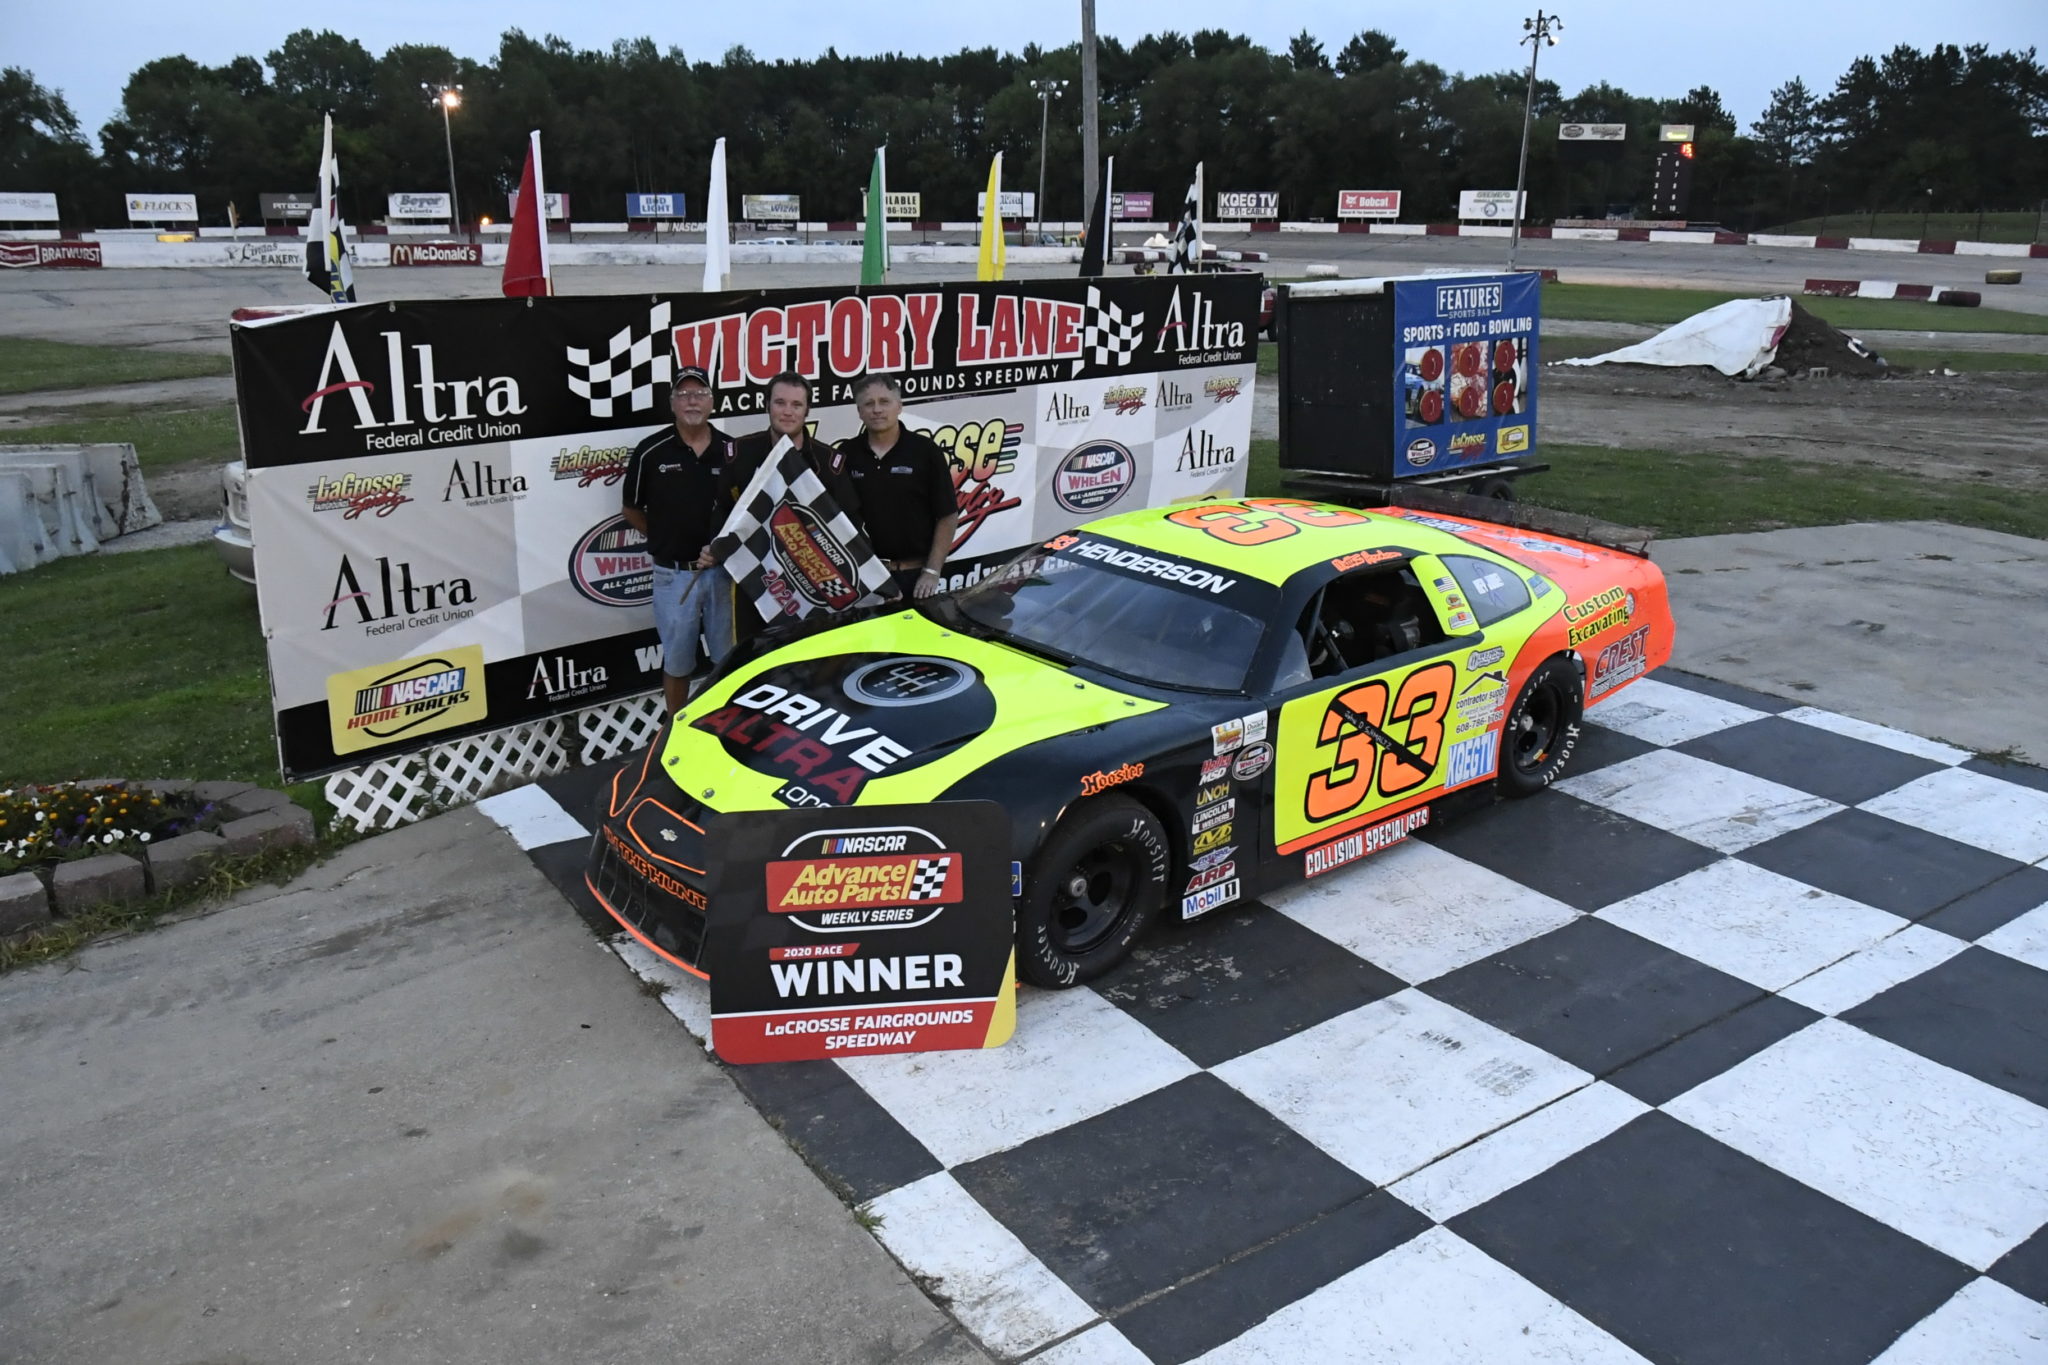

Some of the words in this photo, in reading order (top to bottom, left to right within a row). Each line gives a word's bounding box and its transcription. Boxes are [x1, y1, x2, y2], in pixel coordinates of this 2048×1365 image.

[144, 201, 192, 210] FLOCK'S
[642, 205, 670, 213] LIGHT
[1220, 193, 1258, 207] KQEG
[1259, 193, 1278, 207] TV
[1359, 197, 1389, 207] Bobcat
[41, 247, 100, 263] BRATWURST
[260, 254, 299, 264] BAKERY
[413, 246, 477, 261] McDonald's
[1439, 287, 1500, 310] FEATURES
[1154, 283, 1246, 353] Altra
[1449, 310, 1476, 319] SPORTS
[672, 293, 942, 389] VICTORY
[956, 293, 1085, 366] LANE
[1404, 325, 1444, 343] SPORTS
[1453, 321, 1480, 338] FOOD
[1488, 317, 1532, 335] BOWLING
[1178, 352, 1201, 366] Federal
[1203, 352, 1222, 364] Credit
[1223, 350, 1242, 362] Union
[299, 320, 528, 435] Altra
[975, 365, 1060, 390] SPEEDWAY
[1045, 391, 1090, 422] Altra
[1155, 379, 1193, 408] Altra
[366, 431, 423, 451] Federal
[428, 424, 474, 445] Credit
[477, 421, 521, 440] Union
[1175, 426, 1235, 472] Altra
[558, 445, 628, 472] LaCrosse
[1087, 451, 1116, 468] NASCAR
[316, 472, 404, 503] LaCrosse
[442, 458, 529, 502] Altra
[1068, 467, 1121, 490] WHELEN
[1069, 487, 1118, 501] ALL-AMERICAN
[1081, 496, 1104, 505] SERIES
[1164, 499, 1372, 547] 33
[774, 525, 798, 552] Auto
[794, 548, 821, 583] Parts
[787, 522, 836, 578] Advance
[814, 534, 845, 567] NASCAR
[781, 551, 801, 577] WEEKLY
[798, 573, 817, 595] SERIES
[1068, 540, 1237, 594] HENDERSON
[321, 553, 477, 631] Altra
[624, 583, 653, 594] SERIE
[761, 569, 801, 616] 2020
[1562, 586, 1626, 623] Custom
[366, 621, 405, 637] Federal
[408, 614, 439, 629] Credit
[442, 608, 474, 622] Union
[1567, 604, 1630, 648] Excavating
[1594, 624, 1650, 681] CREST
[390, 669, 460, 705] NASCAR
[526, 656, 609, 700] Altra
[548, 691, 570, 703] Federal
[571, 688, 589, 698] Credit
[589, 682, 607, 692] Union
[347, 706, 401, 730] HOME
[404, 690, 471, 716] TRACKS
[1456, 692, 1488, 710] contractor
[733, 684, 914, 773] DRIVE
[1303, 660, 1456, 823] 33
[699, 706, 868, 803] ALTRA
[1543, 722, 1580, 785] Hoosier
[1081, 763, 1144, 797] Hoosier
[1199, 767, 1227, 787] MSD
[1197, 783, 1230, 806] UNOH
[1196, 803, 1228, 824] LINCOLN
[1201, 812, 1230, 831] WELDERS
[841, 835, 907, 853] NASCAR
[1122, 818, 1165, 882] Hoosier
[1306, 833, 1363, 875] COLLISION
[1365, 809, 1428, 852] SPECIALISTS
[647, 863, 708, 911] HUNT
[794, 862, 907, 887] Advance
[1190, 862, 1234, 891] ARP
[779, 885, 839, 907] Auto
[840, 882, 903, 903] Parts
[1186, 887, 1222, 914] Mobil
[1227, 882, 1235, 897] 1
[821, 910, 869, 926] WEEKLY
[870, 908, 915, 923] SERIES
[783, 946, 812, 958] 2020
[814, 945, 844, 957] RACE
[1037, 924, 1080, 985] Hoosier
[769, 953, 965, 998] WINNER
[764, 1013, 852, 1037] LaCROSSE
[854, 1009, 974, 1031] FAIRGROUNDS
[824, 1030, 917, 1051] SPEEDWAY
